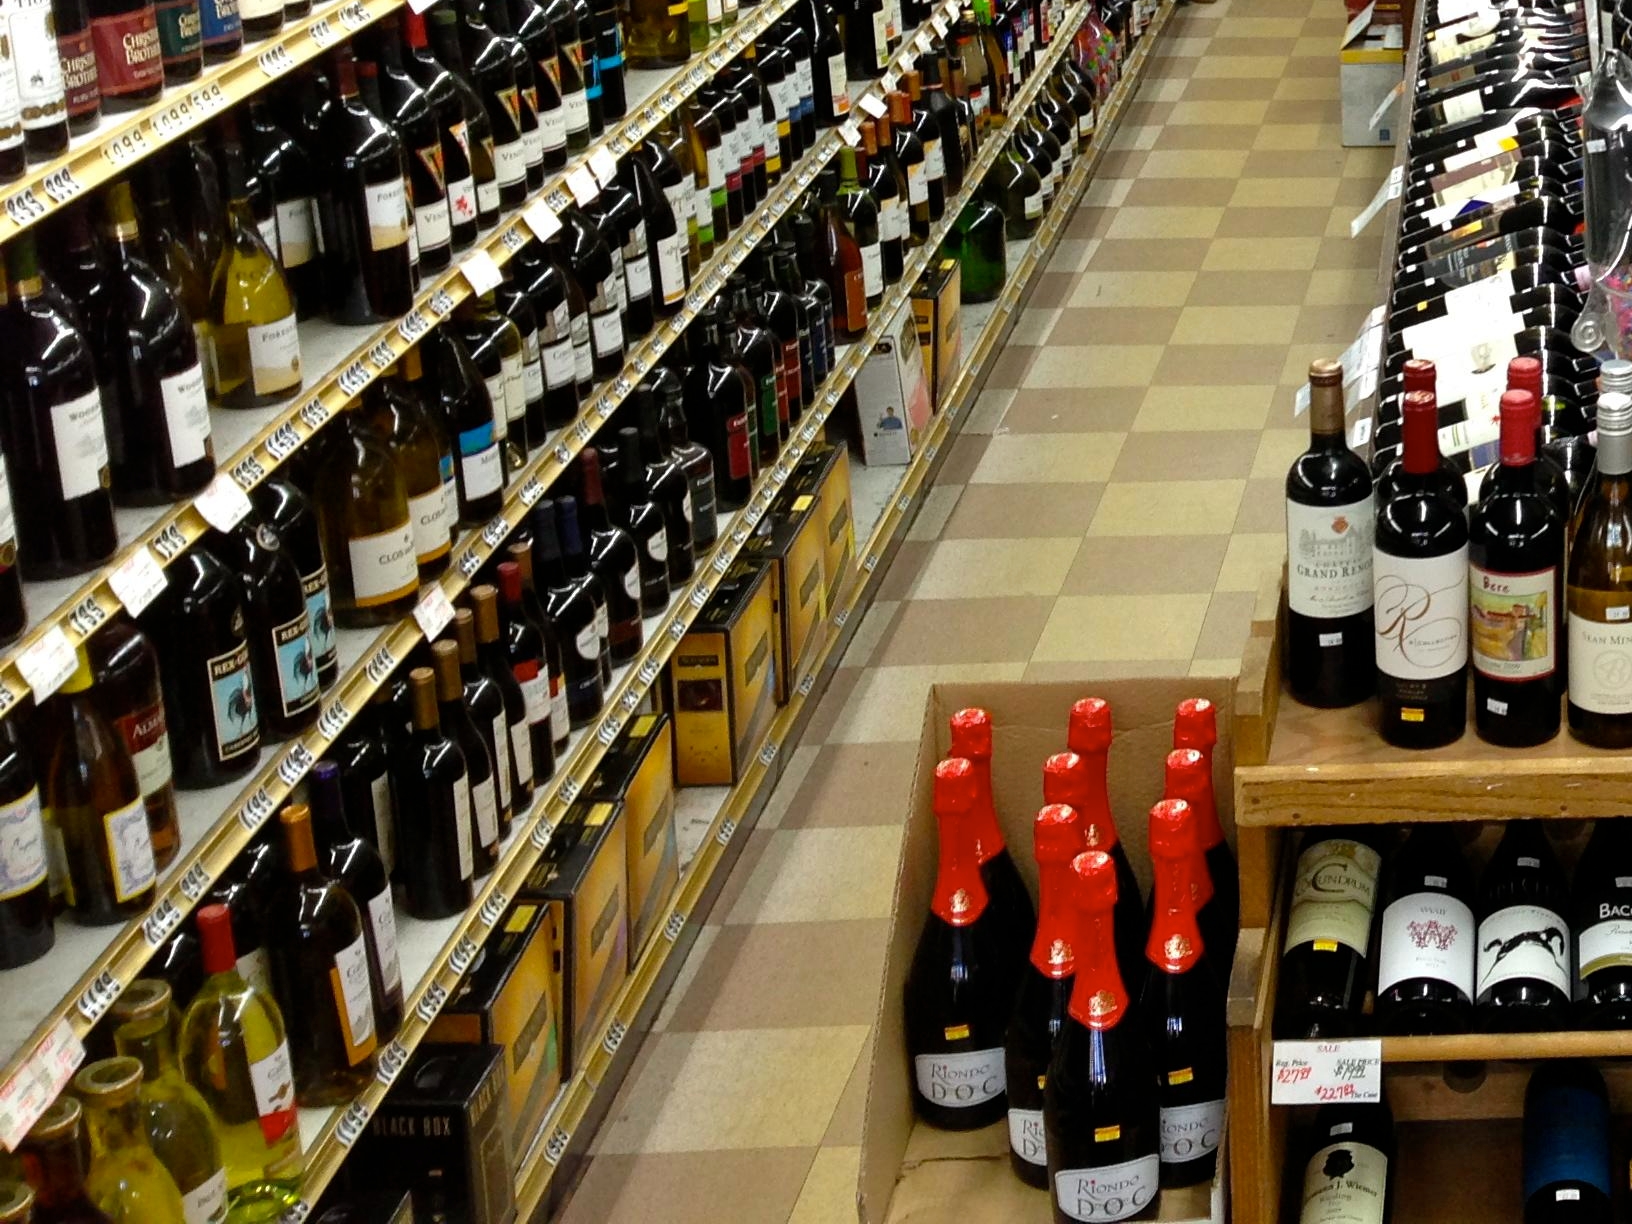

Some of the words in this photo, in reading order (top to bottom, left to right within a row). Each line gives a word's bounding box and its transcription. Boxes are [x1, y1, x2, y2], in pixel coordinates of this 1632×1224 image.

[103, 128, 144, 166] 1099
[1297, 564, 1338, 579] GRAND
[373, 1116, 416, 1136] BLACK
[423, 1116, 451, 1136] BOX
[1077, 1174, 1140, 1198] RIONDO
